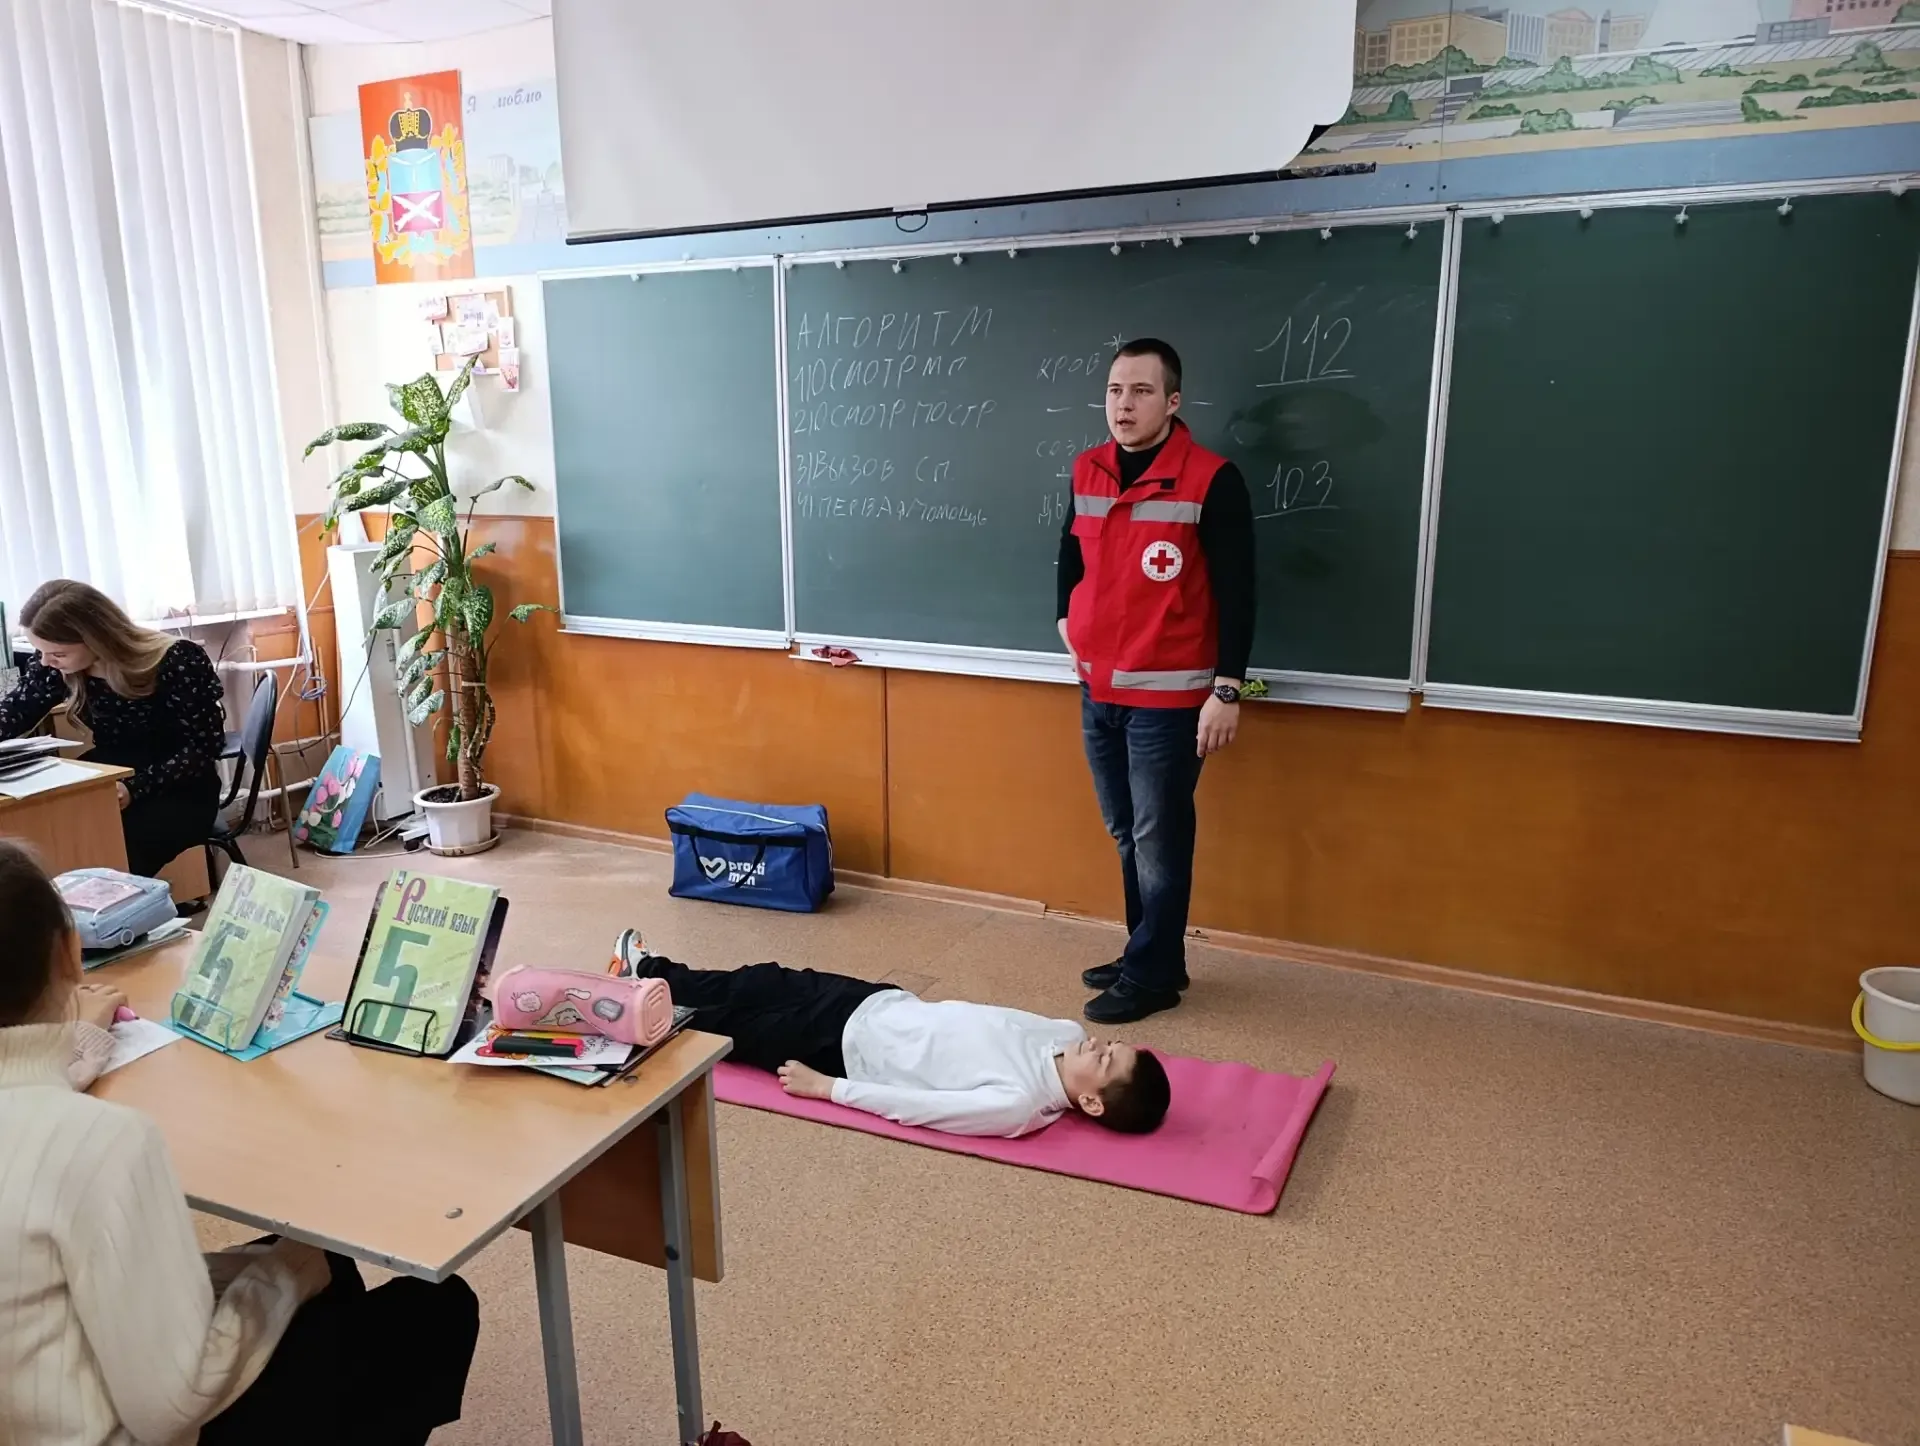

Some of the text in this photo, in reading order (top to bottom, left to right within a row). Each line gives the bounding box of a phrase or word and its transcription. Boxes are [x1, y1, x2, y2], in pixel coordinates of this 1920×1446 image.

[797, 305, 993, 351] АЛГОРИТМ
[1254, 314, 1351, 382] 112
[1266, 460, 1333, 510] 103
[393, 877, 480, 935] Русский язык
[358, 926, 432, 1043] 5
